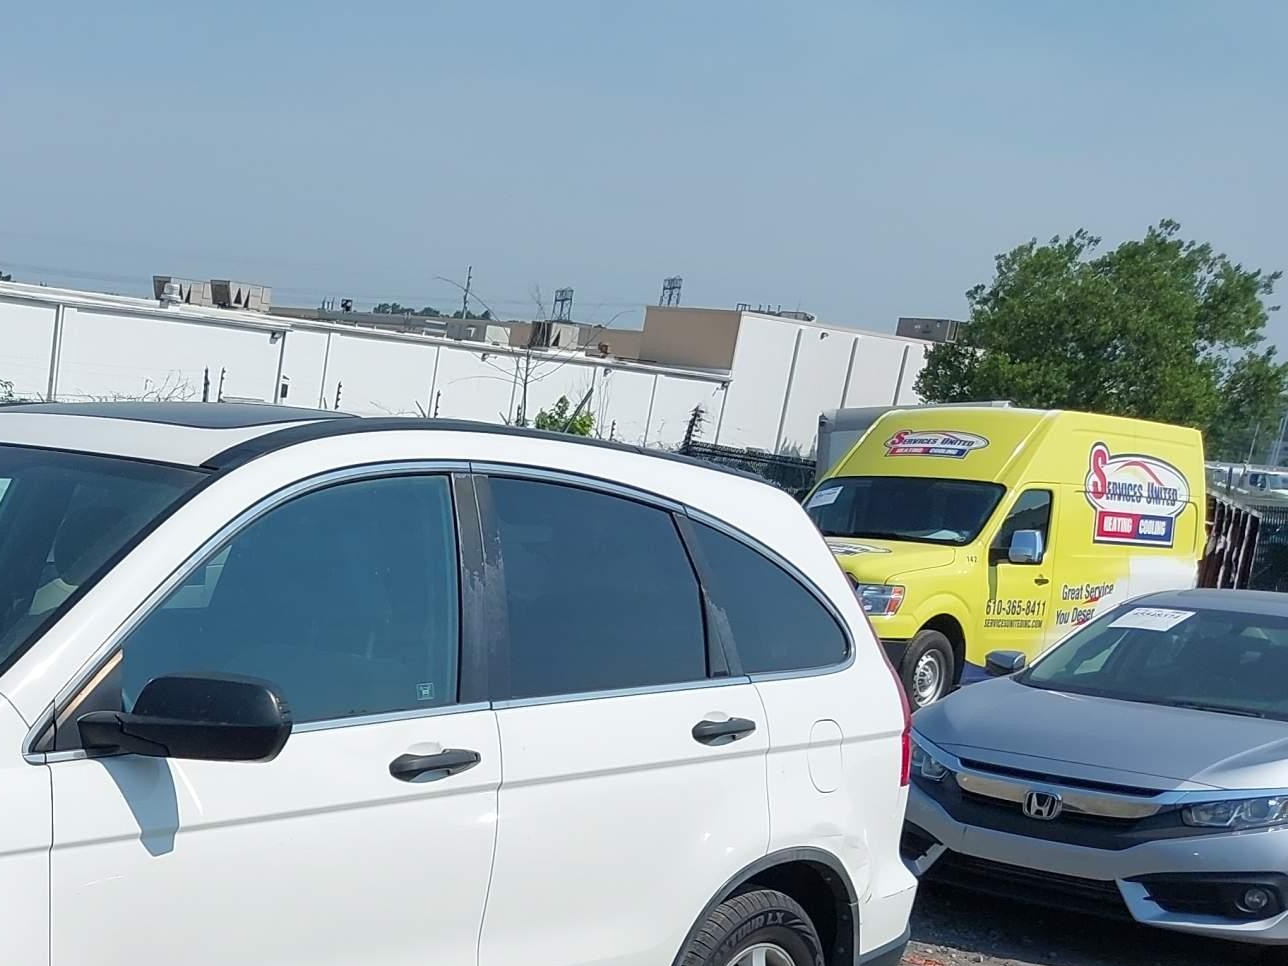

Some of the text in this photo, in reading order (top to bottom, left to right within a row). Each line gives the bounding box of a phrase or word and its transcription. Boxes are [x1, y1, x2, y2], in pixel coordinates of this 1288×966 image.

[890, 431, 975, 447] SERVICES UNITED
[1092, 448, 1178, 507] SERVICES UNITED
[1102, 515, 1166, 536] HEATING COOLING
[966, 555, 978, 563] 142
[1062, 581, 1114, 601] Great Service
[985, 599, 1047, 617] 610-365-8411
[1056, 609, 1069, 625] You
[766, 912, 785, 926] LX
